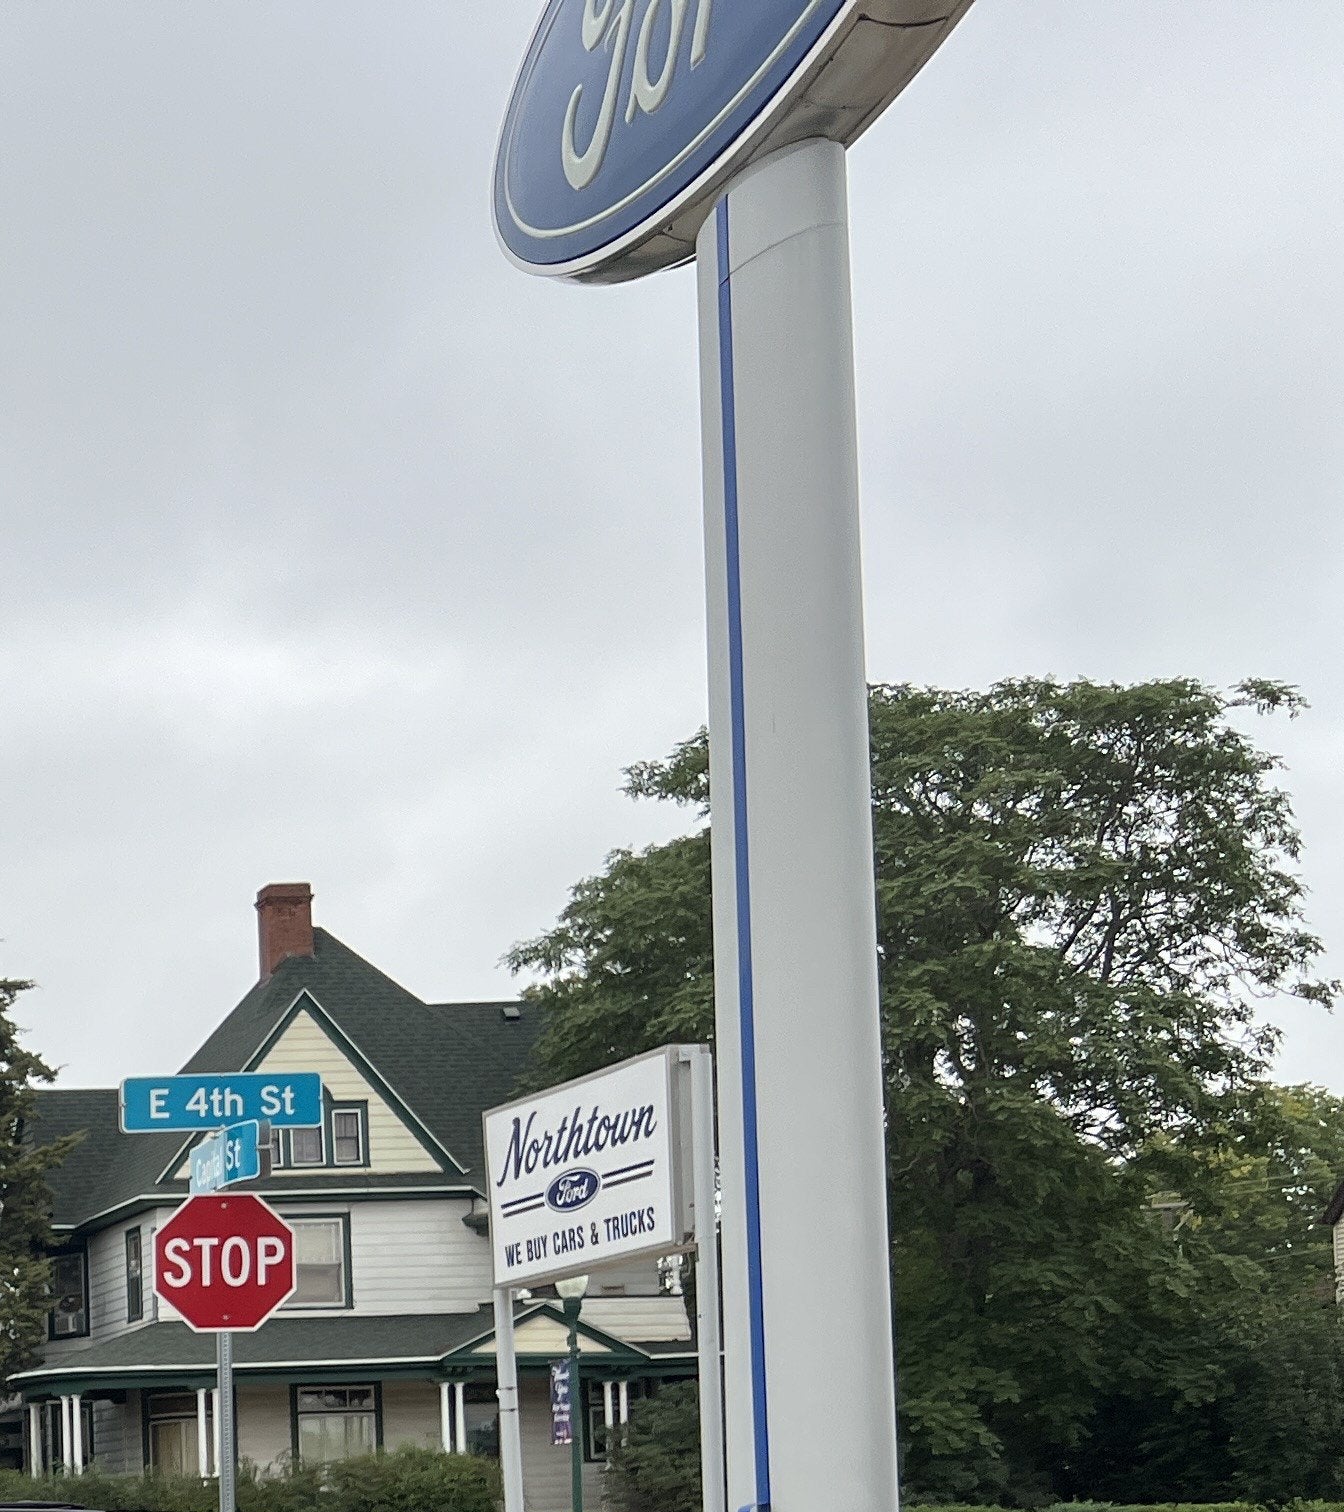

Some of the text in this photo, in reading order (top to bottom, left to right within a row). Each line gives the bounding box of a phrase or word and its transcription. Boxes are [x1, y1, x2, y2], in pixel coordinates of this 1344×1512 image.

[149, 1084, 296, 1119] E 4th St
[225, 1137, 242, 1171] St
[497, 1103, 657, 1187] Northtown
[556, 1173, 591, 1206] Ford
[505, 1206, 656, 1268] WE BUY CARS & TRUCKS
[163, 1235, 285, 1289] STOP
